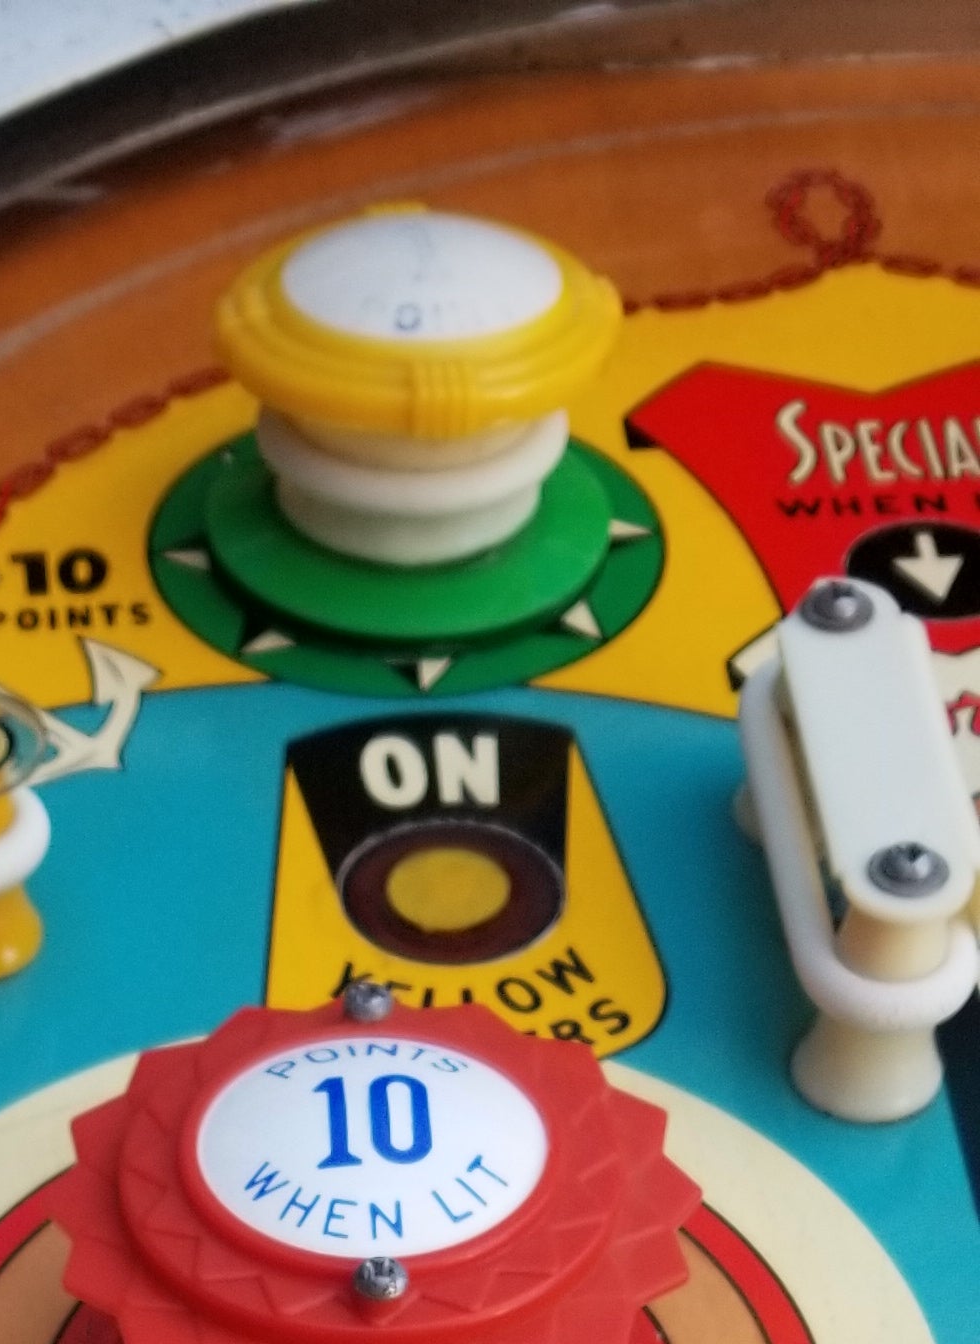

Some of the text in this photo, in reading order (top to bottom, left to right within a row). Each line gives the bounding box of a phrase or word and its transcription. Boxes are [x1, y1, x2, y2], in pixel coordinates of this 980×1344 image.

[775, 400, 980, 486] SPECIA
[777, 494, 948, 518] WHEN
[8, 547, 109, 596] 10
[358, 732, 500, 811] ON
[265, 1042, 469, 1080] POINTS
[312, 1073, 433, 1169] 10
[244, 1154, 509, 1240] WHEN LIT
